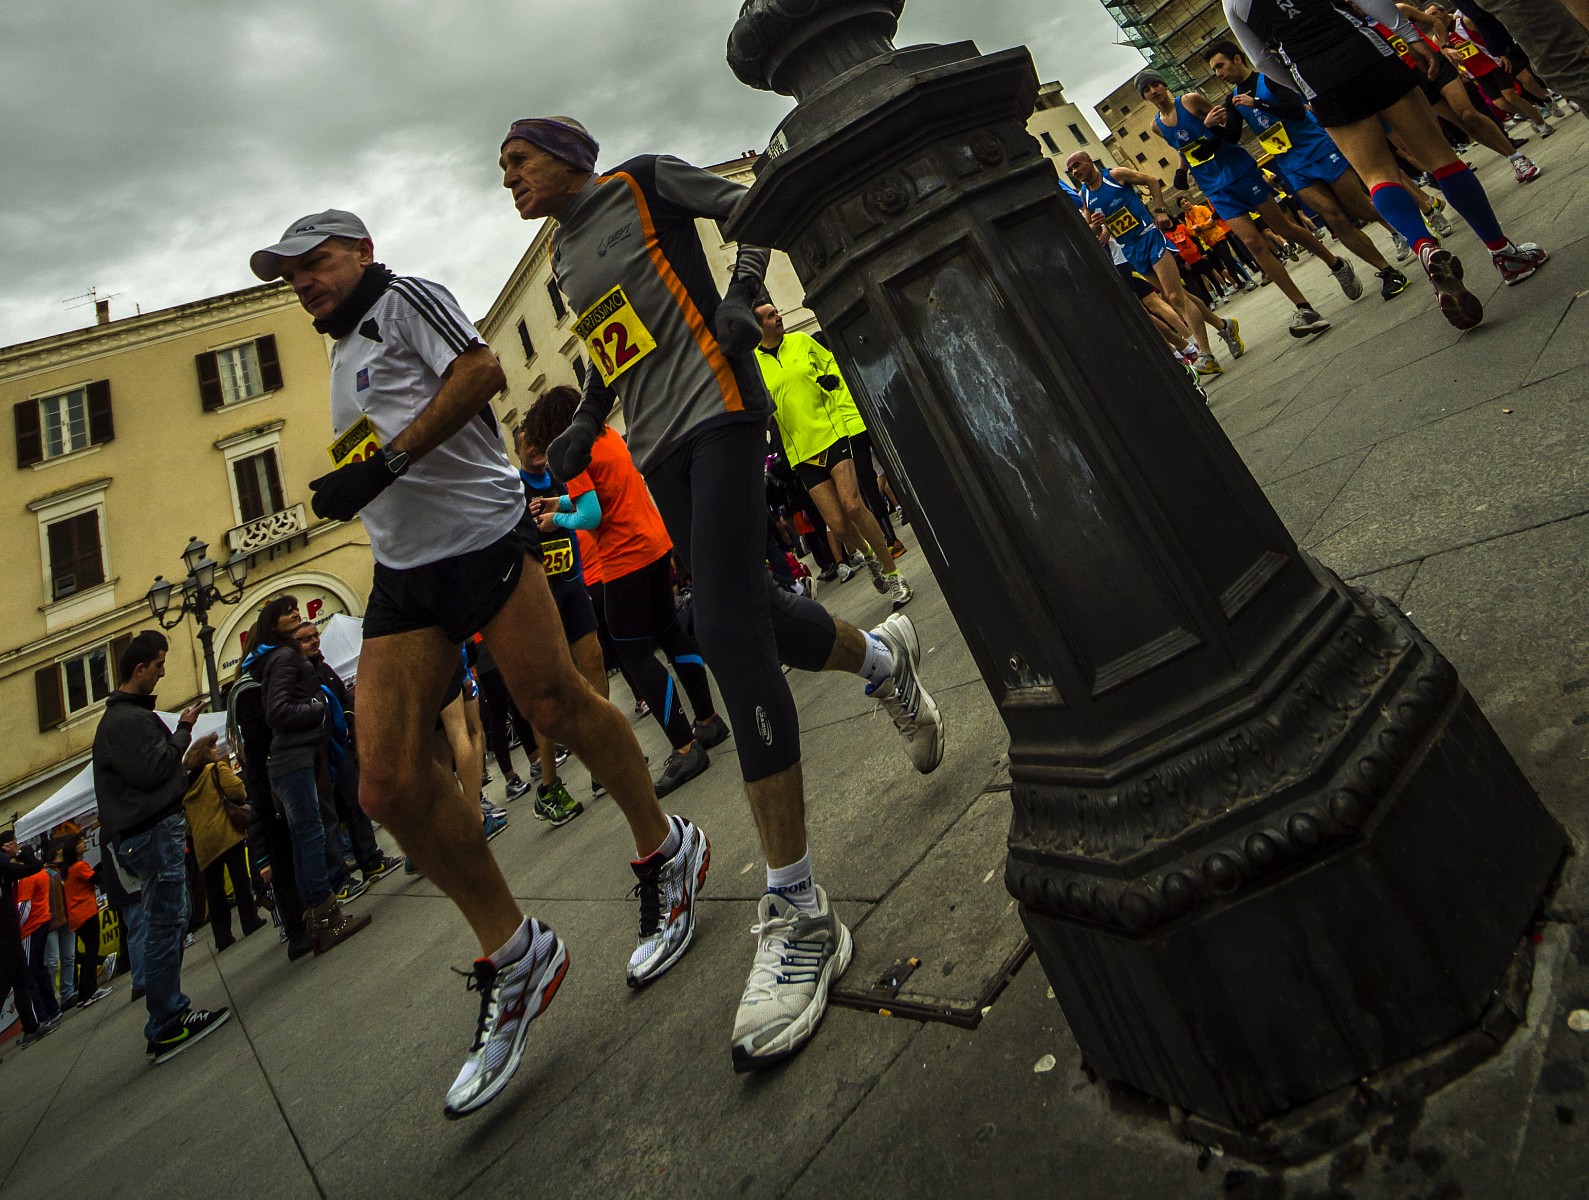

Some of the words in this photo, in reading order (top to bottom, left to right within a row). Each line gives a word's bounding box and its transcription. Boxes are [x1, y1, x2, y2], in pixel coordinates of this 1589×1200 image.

[295, 225, 316, 234] FILA
[1110, 214, 1137, 235] 122
[576, 292, 624, 339] SPORTISSIMO
[543, 550, 571, 573] 251
